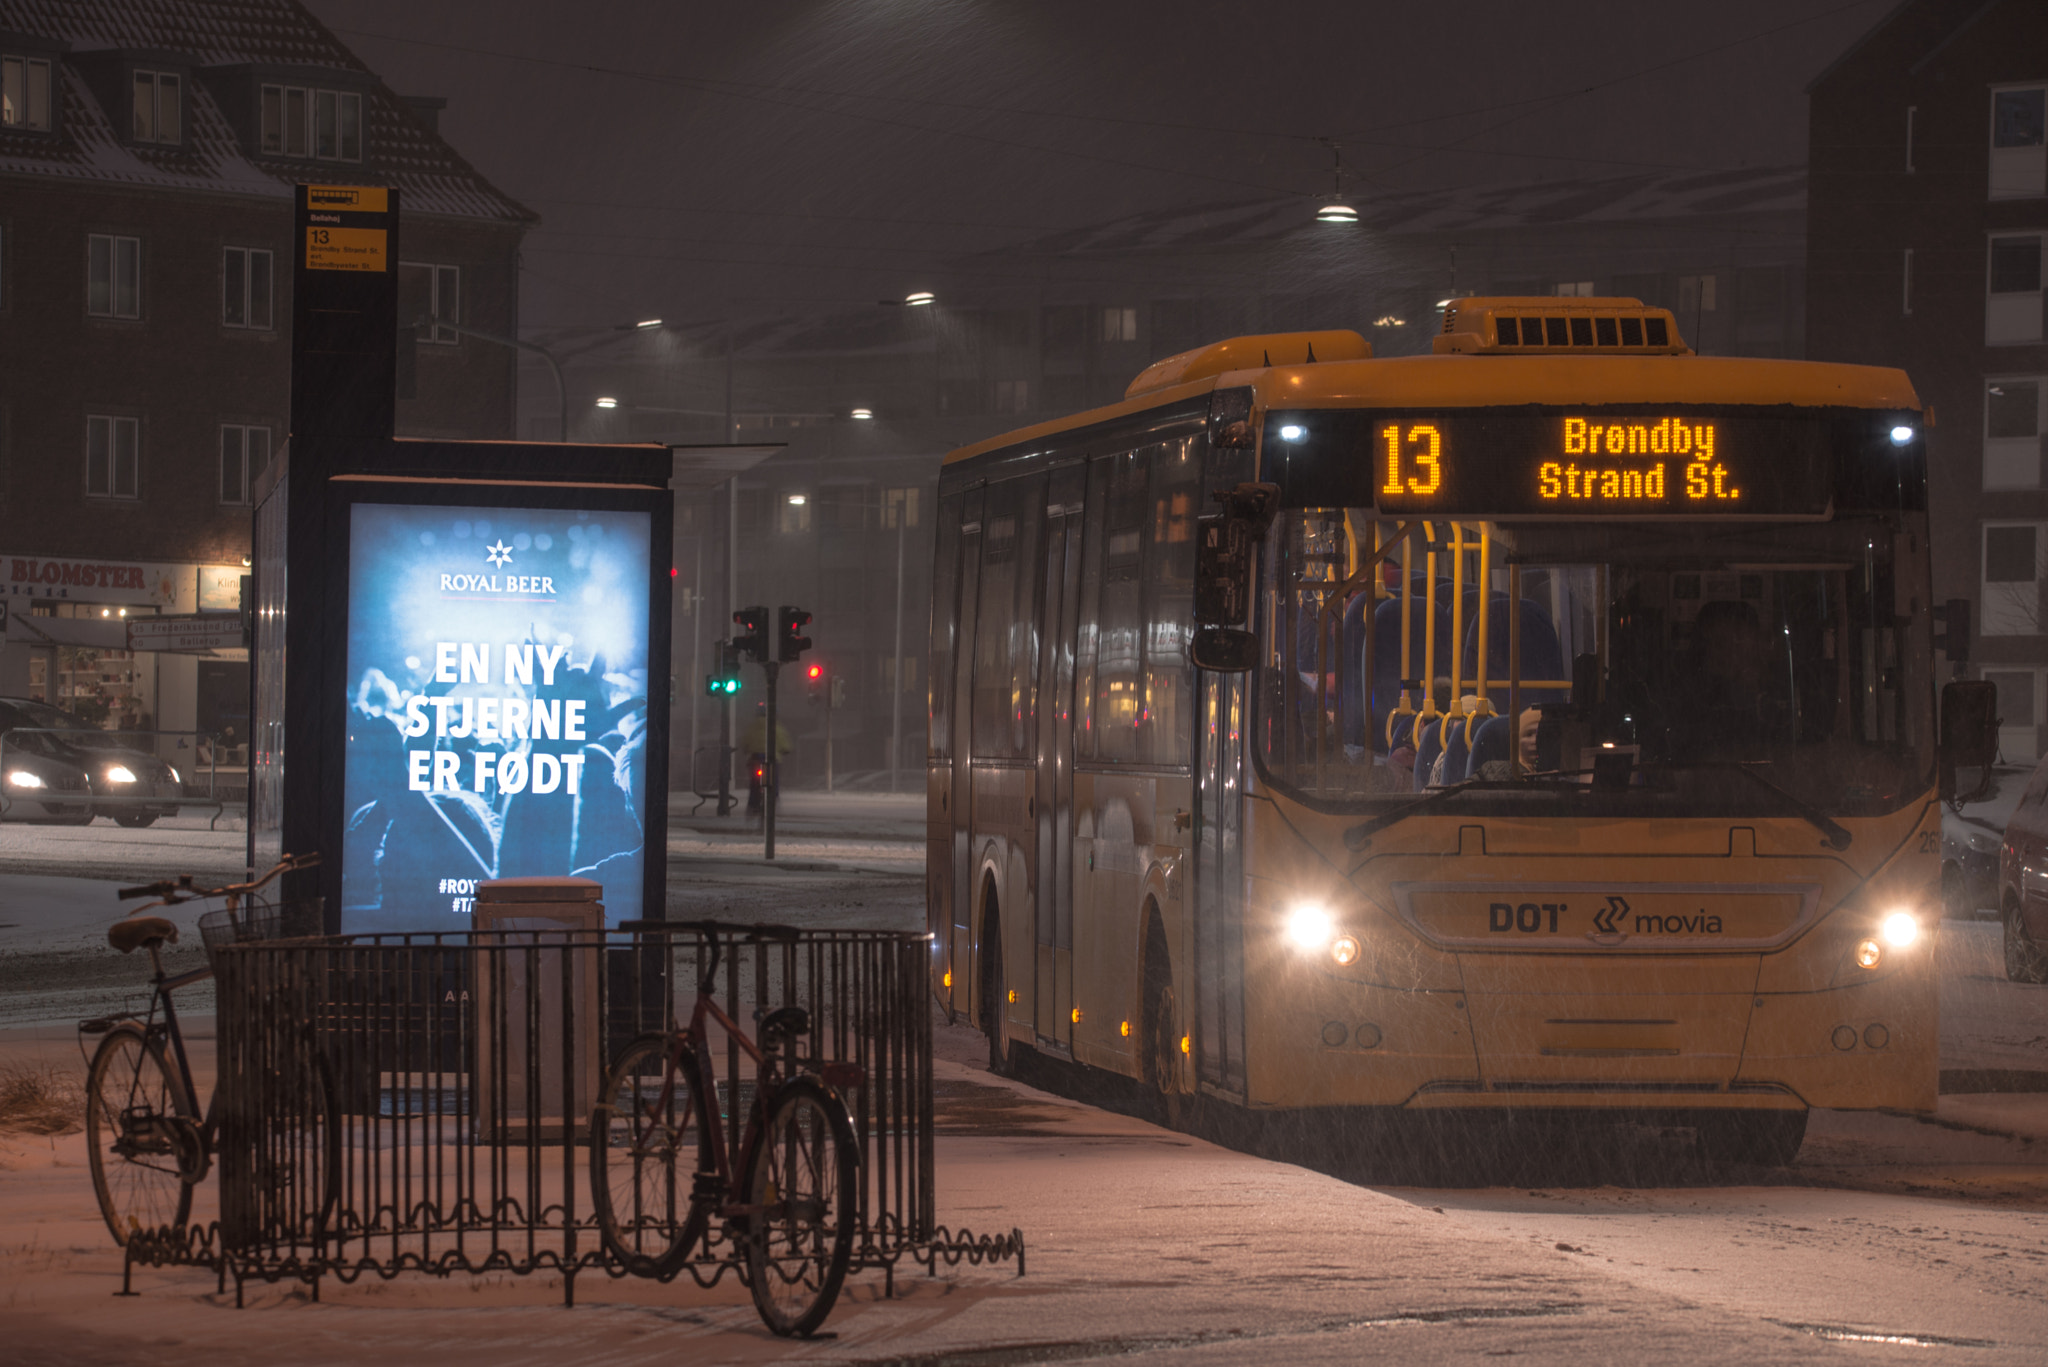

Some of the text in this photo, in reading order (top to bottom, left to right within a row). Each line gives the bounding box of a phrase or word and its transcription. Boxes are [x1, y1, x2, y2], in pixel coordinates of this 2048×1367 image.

[311, 230, 330, 244] 13
[1565, 418, 1714, 461] Brøndby
[1383, 425, 1441, 495] 13
[1540, 462, 1740, 499] Strand St.
[11, 559, 146, 589] BLOMSTER
[218, 577, 240, 588] Klini
[440, 573, 557, 594] ROYAL BEER
[436, 642, 564, 685] EN NY
[405, 695, 586, 741] STJERNE
[408, 750, 586, 795] ER FØDT
[439, 878, 481, 895] #ROY
[1489, 903, 1723, 933] DOT movia
